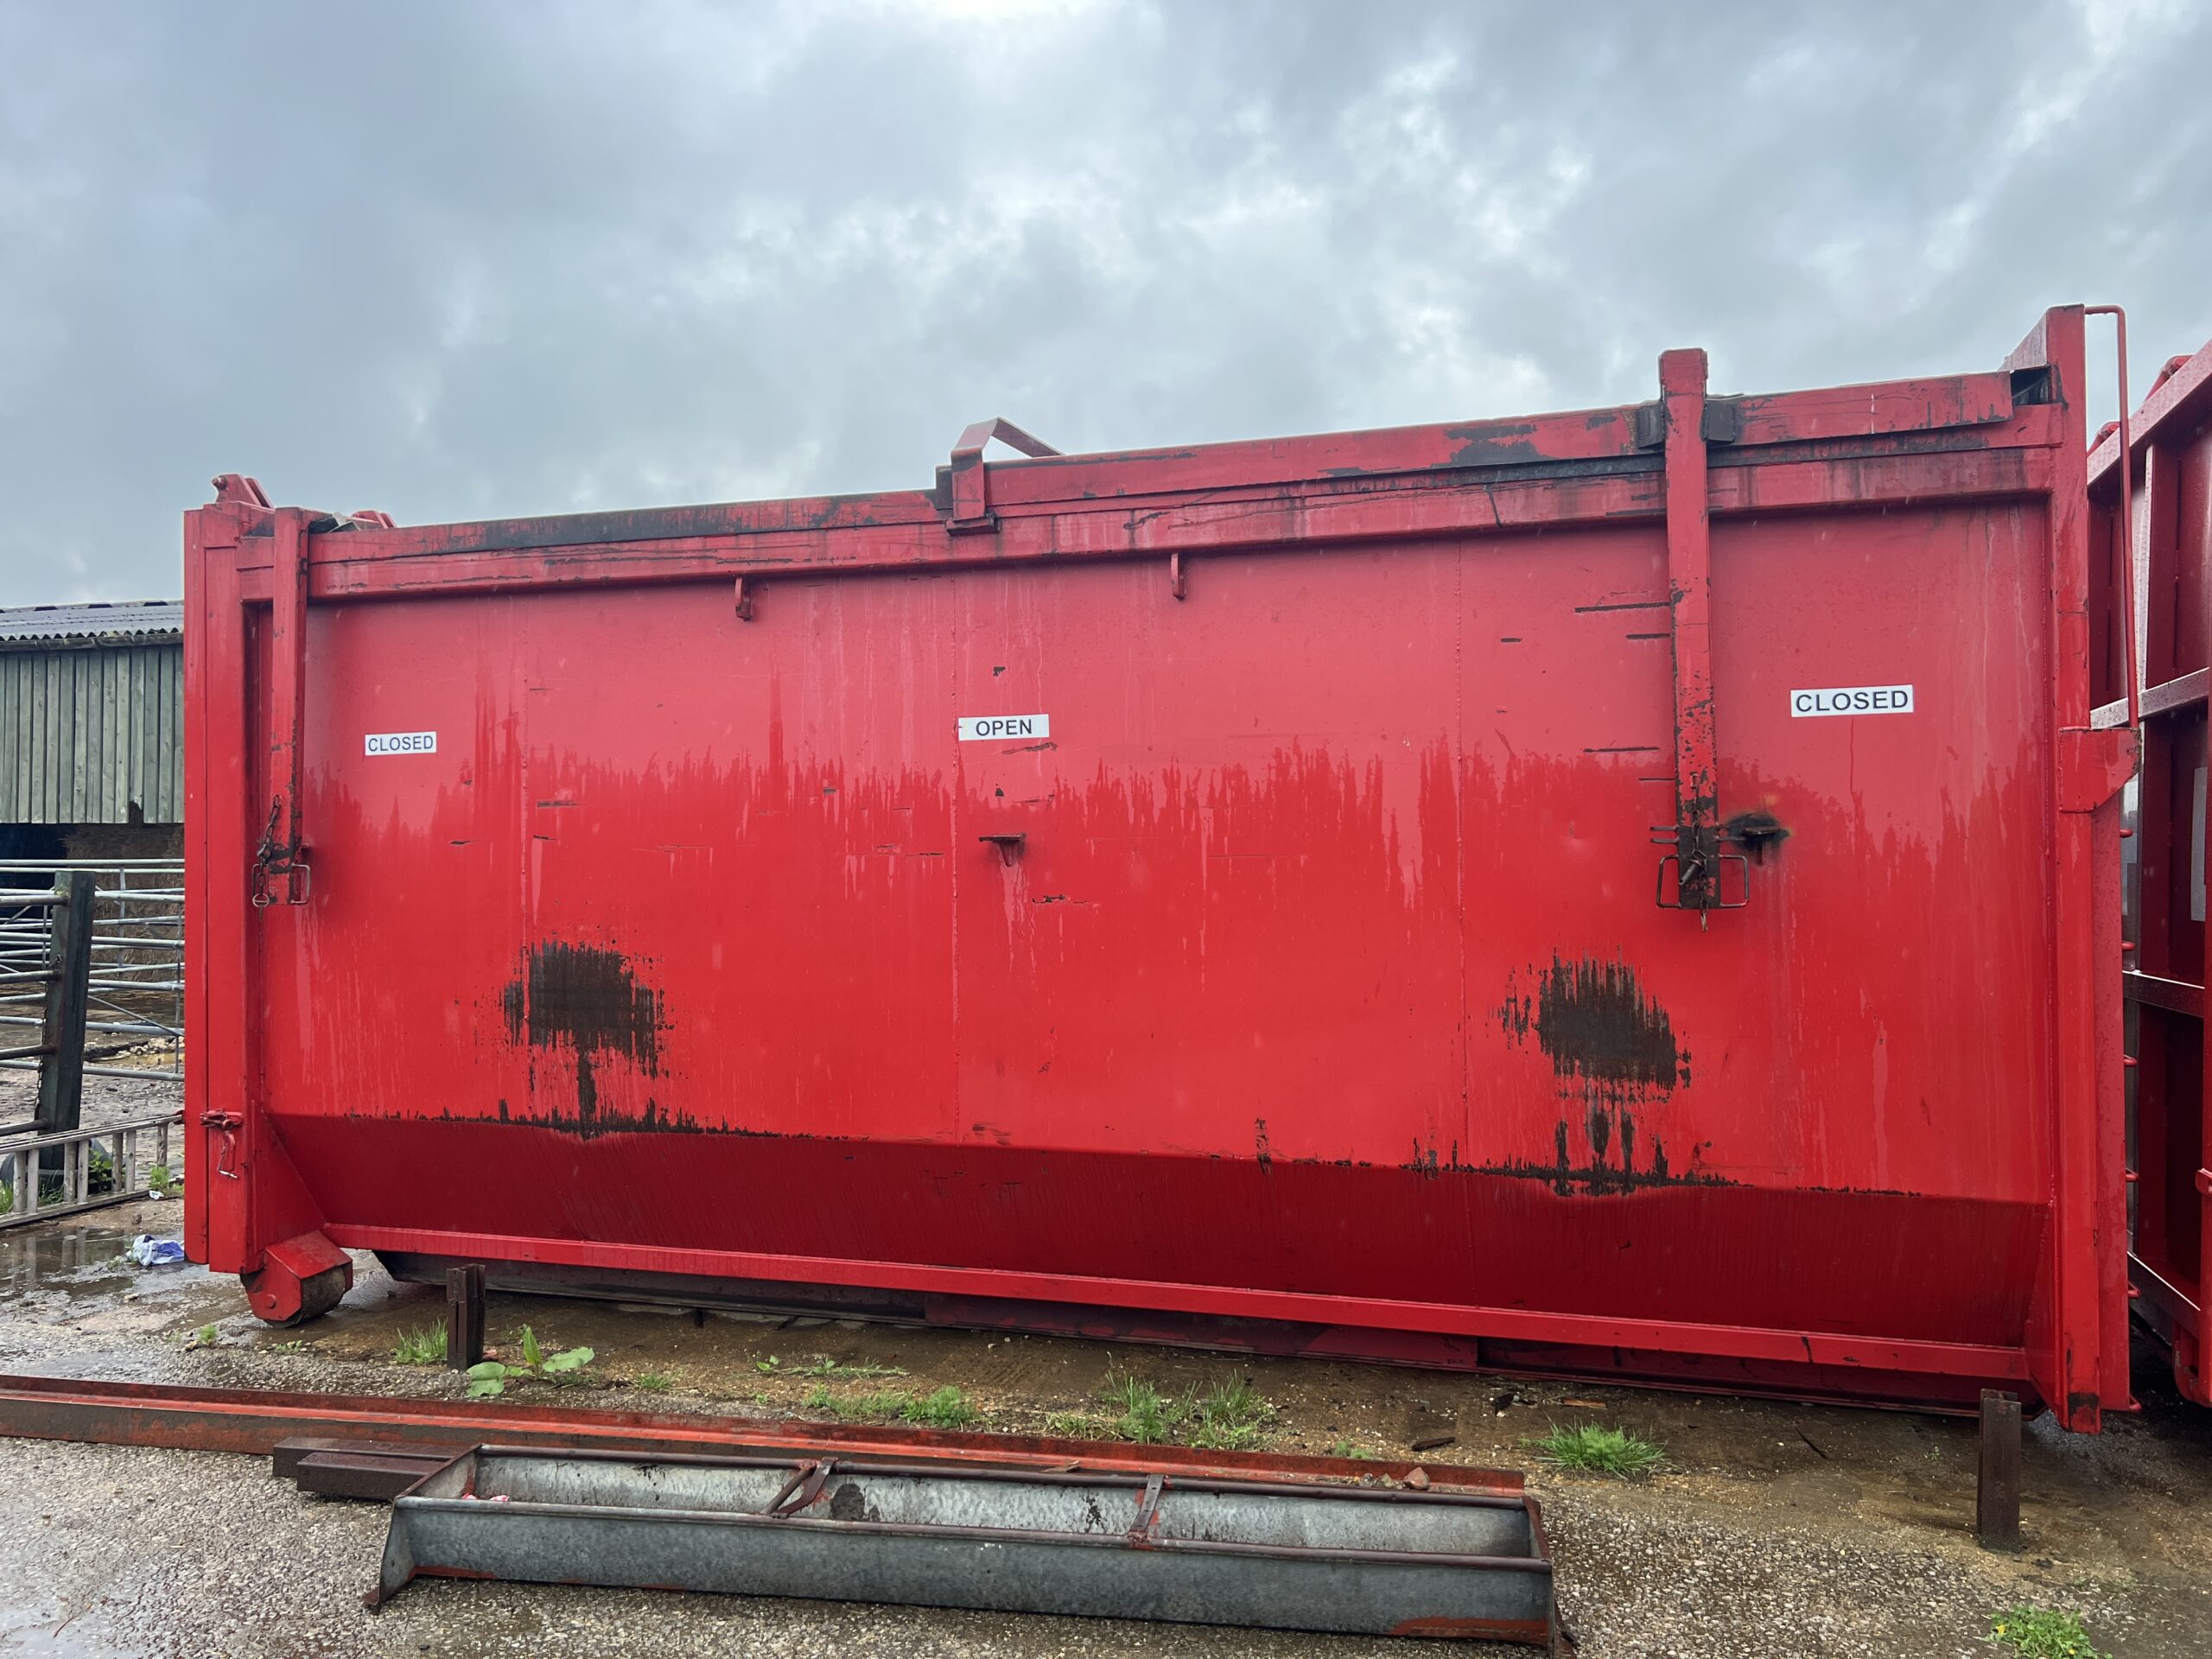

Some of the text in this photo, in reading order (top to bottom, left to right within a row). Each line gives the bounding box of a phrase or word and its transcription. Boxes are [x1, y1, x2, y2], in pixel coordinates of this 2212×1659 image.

[1796, 690, 1909, 713] CLOSED
[976, 718, 1033, 736] OPEN
[368, 734, 434, 752] CLOSED
